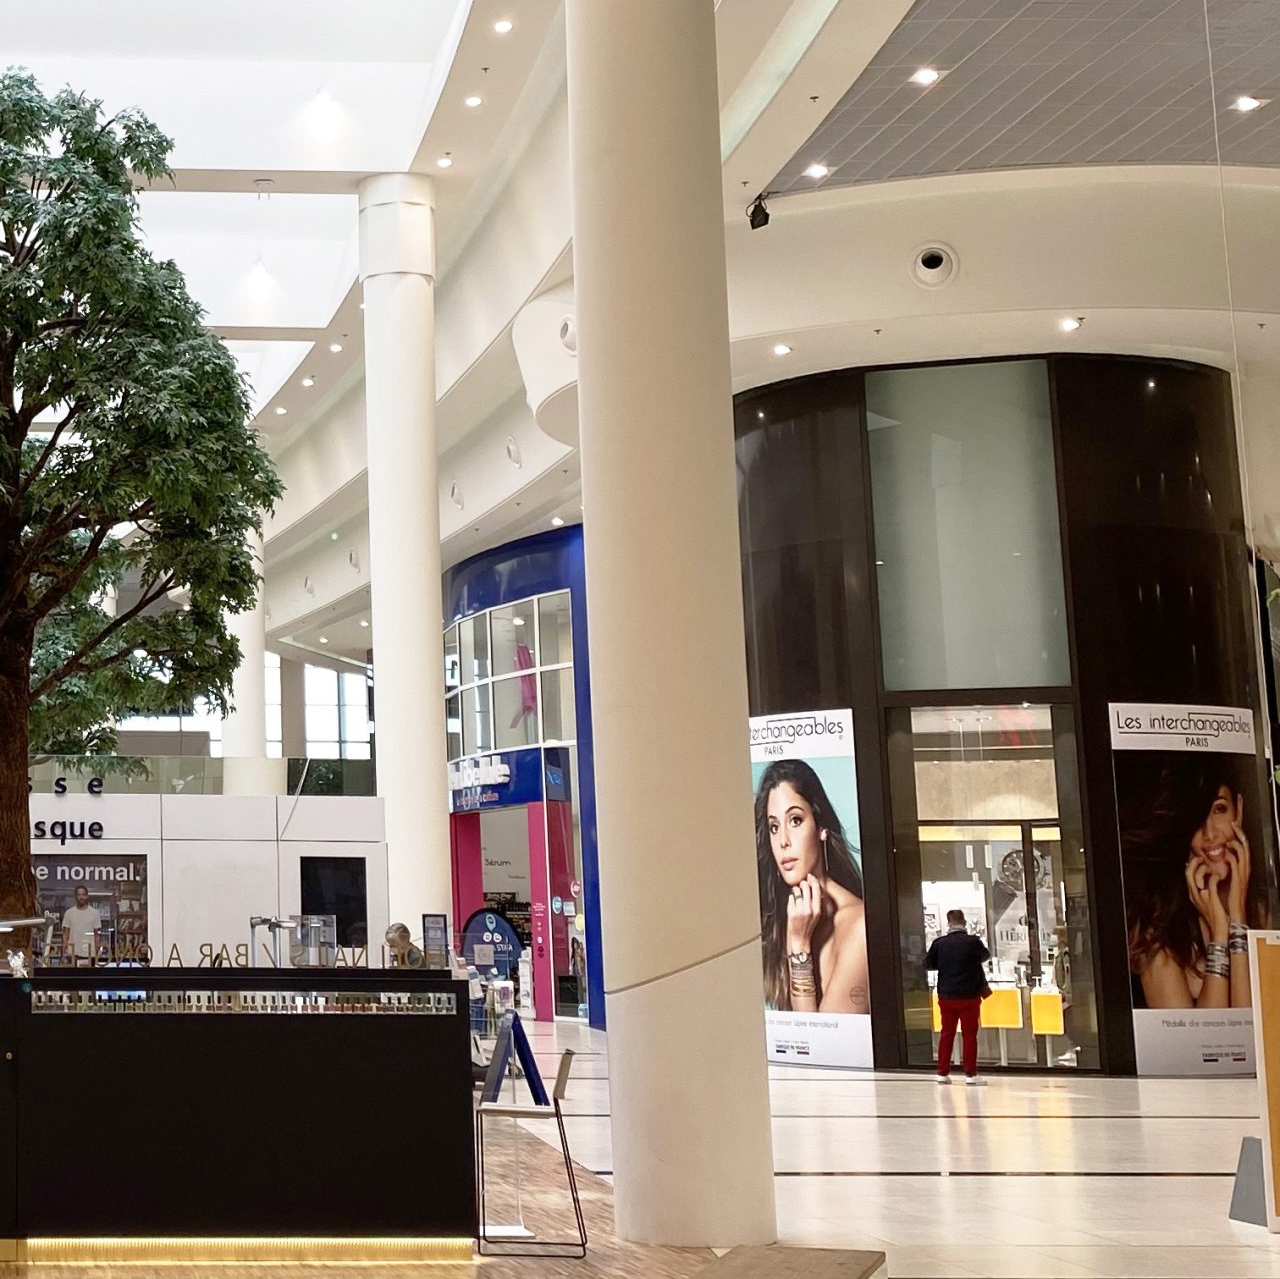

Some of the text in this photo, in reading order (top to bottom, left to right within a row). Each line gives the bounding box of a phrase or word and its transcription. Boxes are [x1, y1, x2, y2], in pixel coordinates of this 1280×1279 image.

[748, 715, 844, 743] erchangeables
[1116, 710, 1251, 738] Les interchangeables
[764, 746, 784, 755] PARIS
[1185, 737, 1209, 748] PARIS
[31, 862, 141, 882] e normal.
